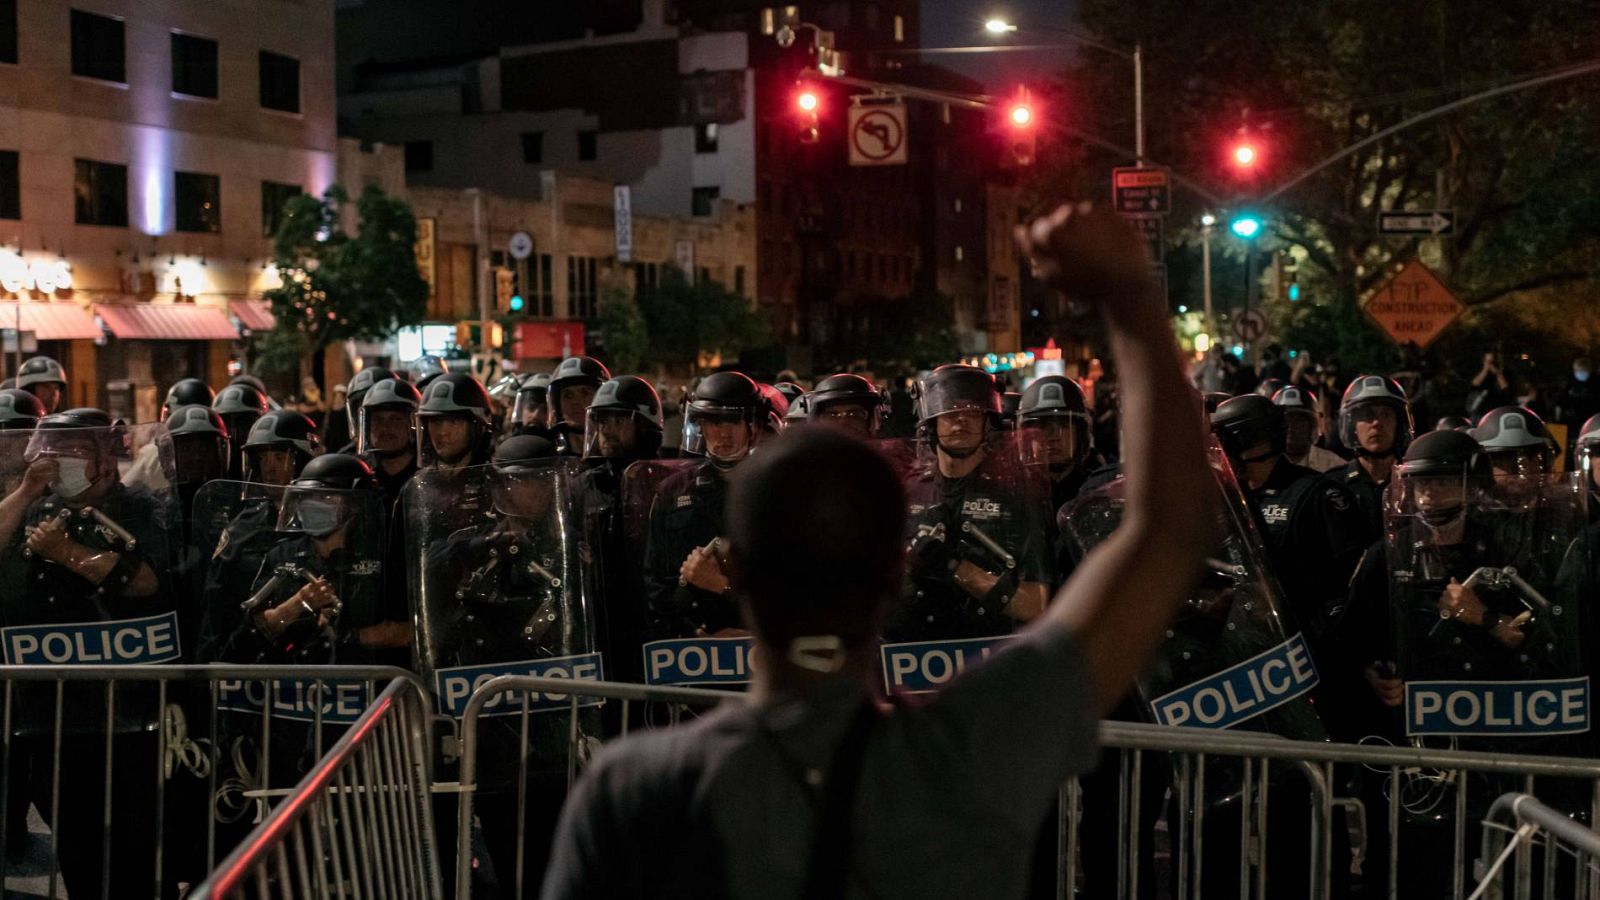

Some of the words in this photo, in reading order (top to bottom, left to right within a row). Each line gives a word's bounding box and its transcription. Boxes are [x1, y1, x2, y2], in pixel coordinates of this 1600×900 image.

[1371, 302, 1457, 314] CONSTRUCTION
[1394, 320, 1434, 332] AHEAD
[963, 501, 1001, 512] POLICE
[12, 622, 175, 664] POLICE
[651, 645, 755, 680] POLI
[1163, 644, 1314, 727] POLICE
[1414, 688, 1586, 727] POLICE
